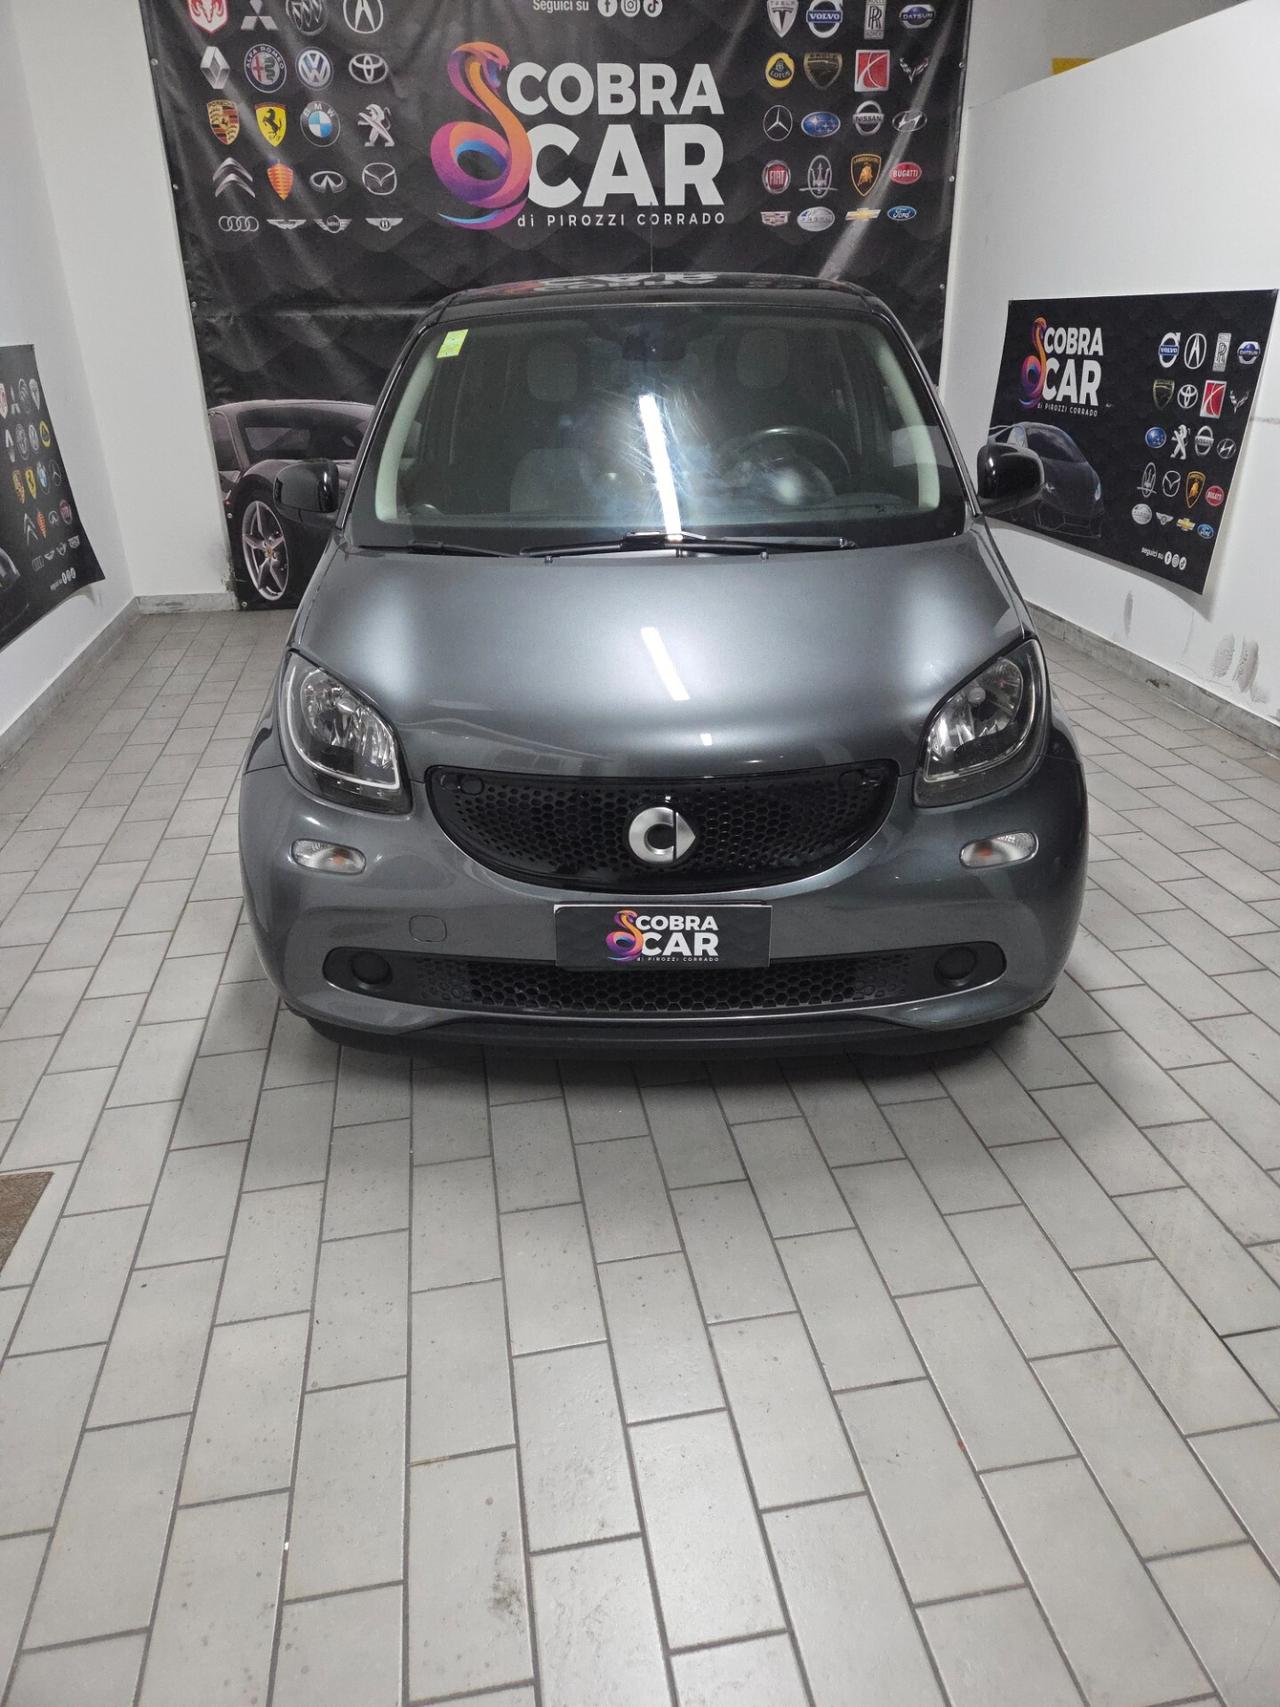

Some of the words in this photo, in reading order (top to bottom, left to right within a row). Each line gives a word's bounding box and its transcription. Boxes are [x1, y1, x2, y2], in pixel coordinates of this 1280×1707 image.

[533, 0, 573, 13] Seguici
[576, 0, 590, 11] su
[506, 62, 724, 116] COBRA
[302, 103, 336, 119] BMW
[855, 115, 882, 123] NISSAN
[527, 123, 724, 208] CAR
[892, 168, 919, 178] BUGATTI
[517, 214, 534, 227] di
[547, 214, 625, 227] PIROZZI
[637, 212, 725, 225] CORRADO
[892, 207, 911, 219] Ford
[1043, 327, 1104, 356] COBRA
[1042, 357, 1102, 406] CAR
[1069, 406, 1098, 417] CORRADO
[635, 915, 719, 931] COBRA
[641, 931, 719, 956] CAR
